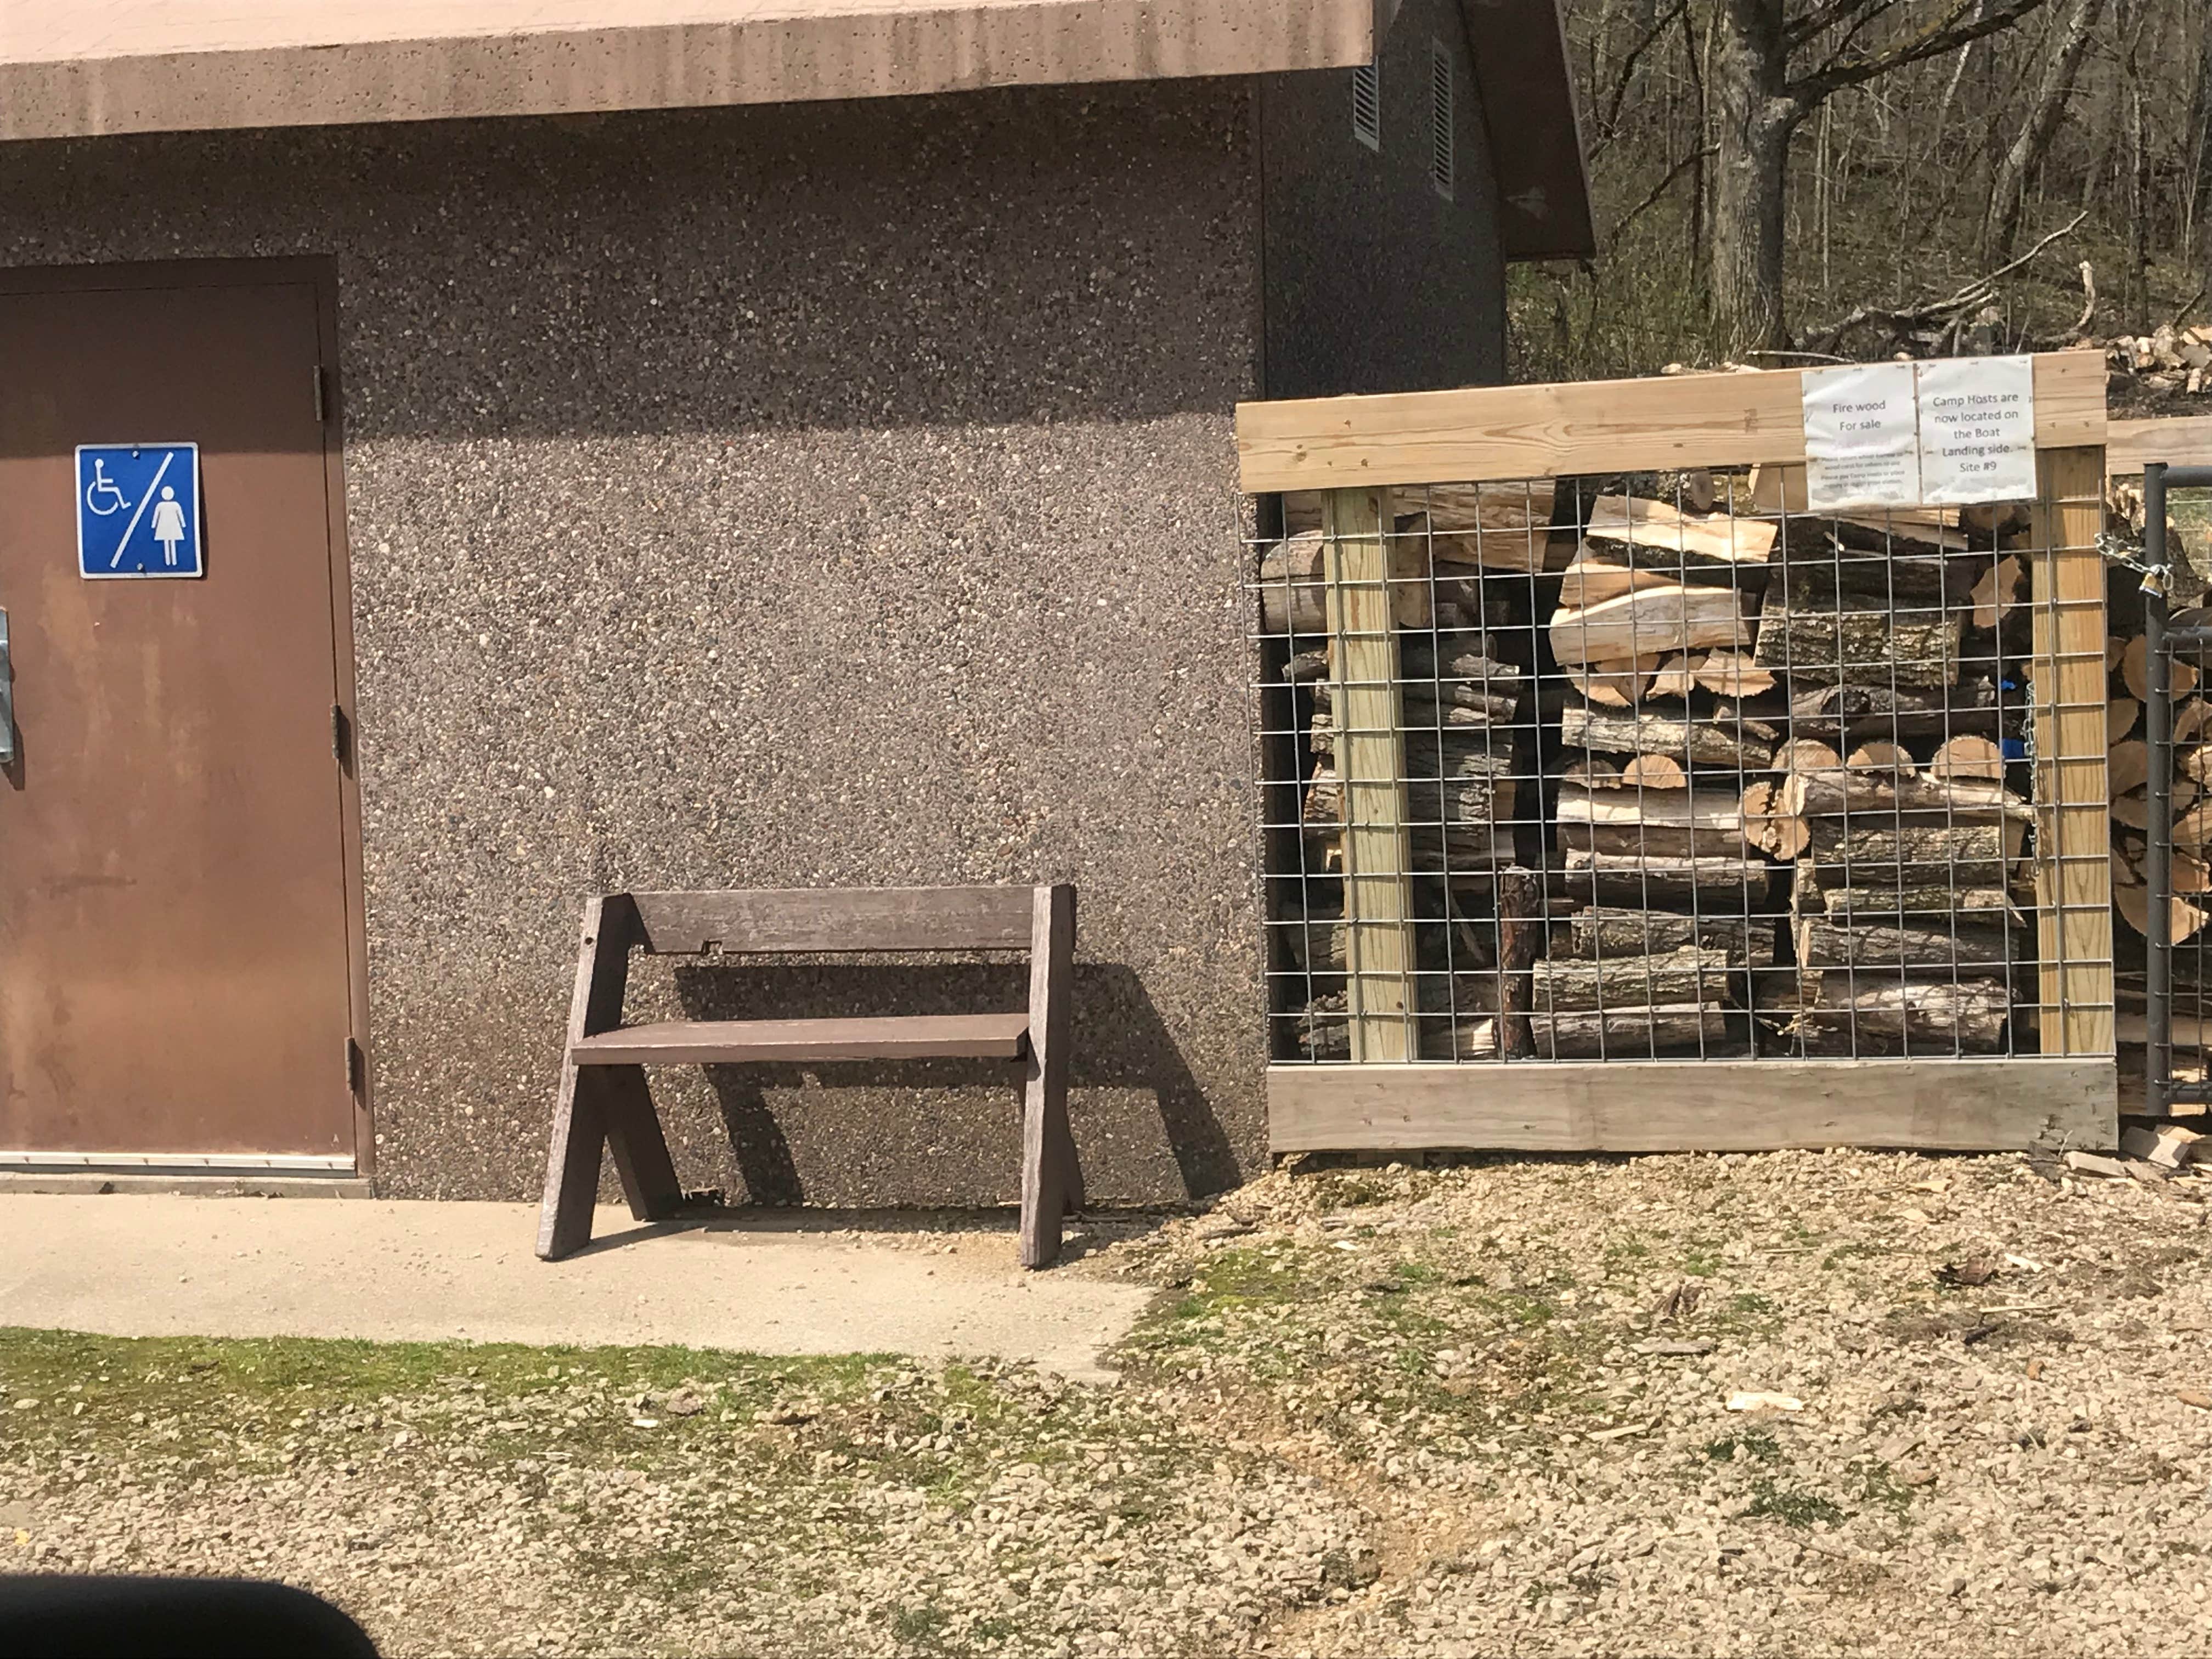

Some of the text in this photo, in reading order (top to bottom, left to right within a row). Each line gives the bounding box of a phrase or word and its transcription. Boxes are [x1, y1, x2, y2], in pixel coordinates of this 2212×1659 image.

[1833, 400, 1886, 413] Fire wood
[1933, 394, 2018, 407] Camp Hosts are
[1934, 410, 2018, 423] now located on
[1839, 420, 1881, 431] For sale
[1954, 428, 2000, 439] the Boat
[1942, 445, 1985, 458] Landing
[1960, 461, 1997, 472] Site #9
